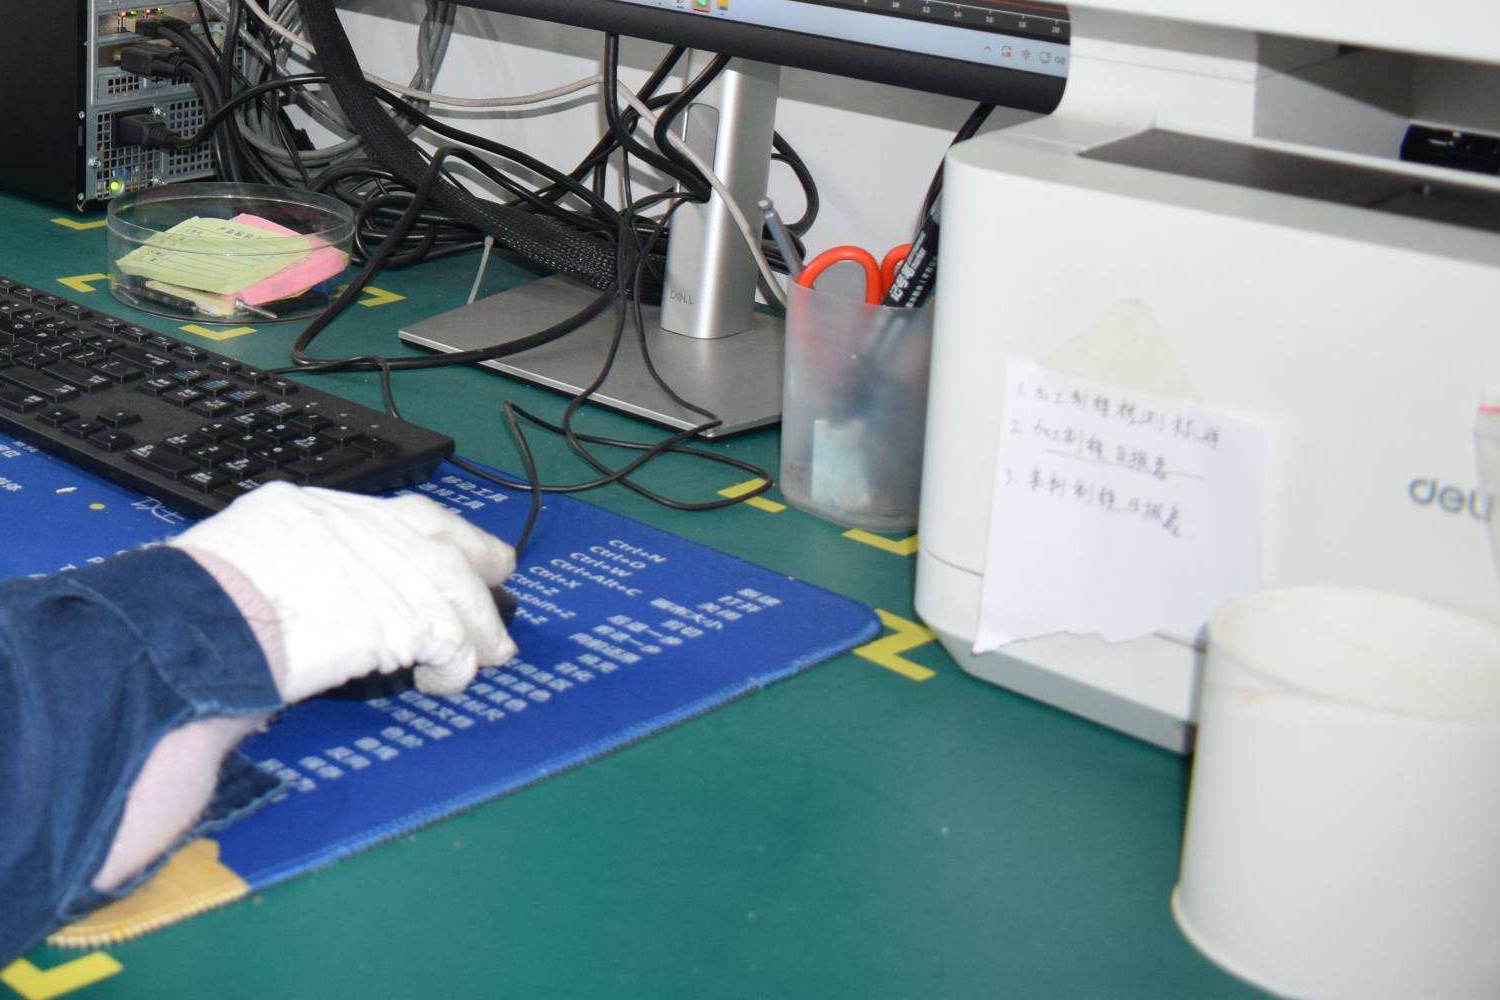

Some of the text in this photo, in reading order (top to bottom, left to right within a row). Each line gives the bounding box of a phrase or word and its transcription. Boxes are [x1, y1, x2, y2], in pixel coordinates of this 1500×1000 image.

[589, 545, 647, 569] Ctrl+O
[608, 539, 667, 563] Ctrl+N
[569, 552, 633, 578] Ctrl+W
[509, 572, 561, 596] Ctrl+Z
[528, 566, 584, 589] Ctrl+X
[550, 558, 643, 597] Ctrl+Alt+C
